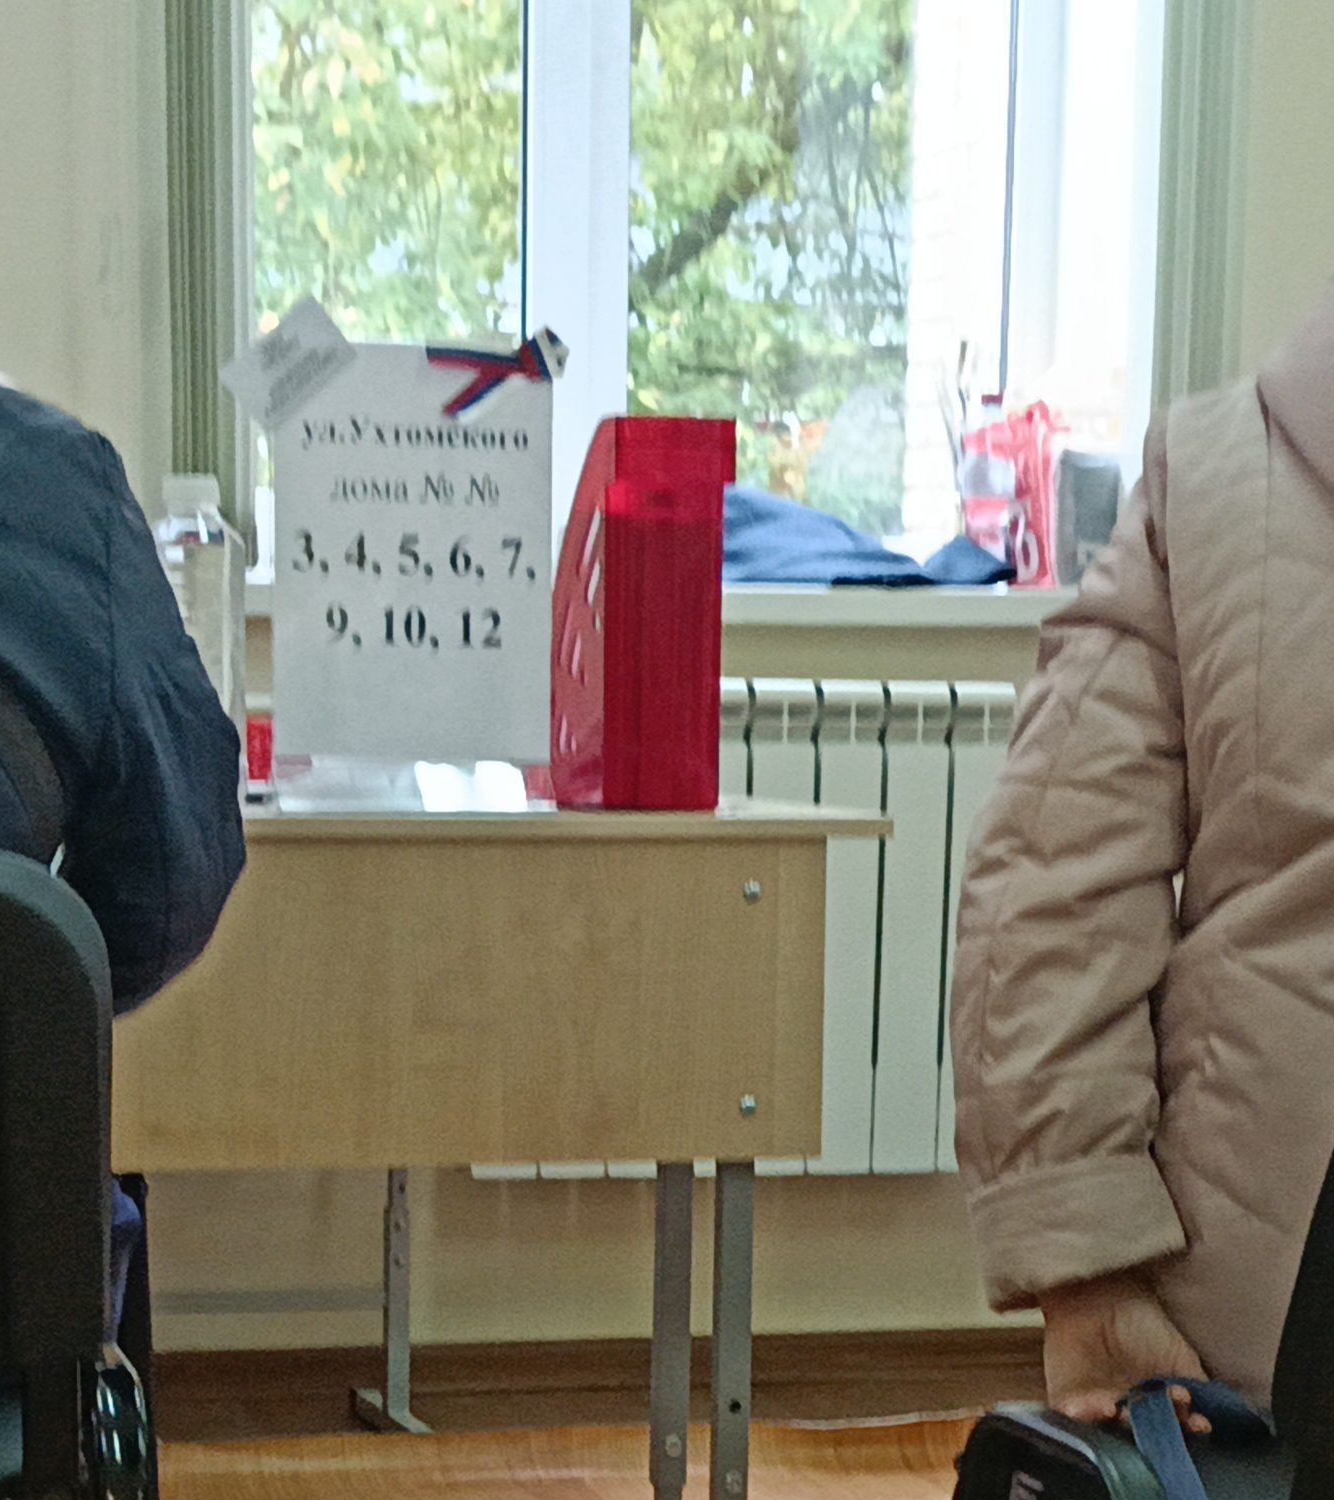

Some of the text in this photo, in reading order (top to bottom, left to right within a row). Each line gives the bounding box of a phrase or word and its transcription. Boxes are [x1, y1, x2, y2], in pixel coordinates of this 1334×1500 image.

[330, 476, 409, 504] дома
[292, 529, 536, 585] 3, 4, 5, 6, 7,
[326, 601, 502, 652] 9, 10, 12
